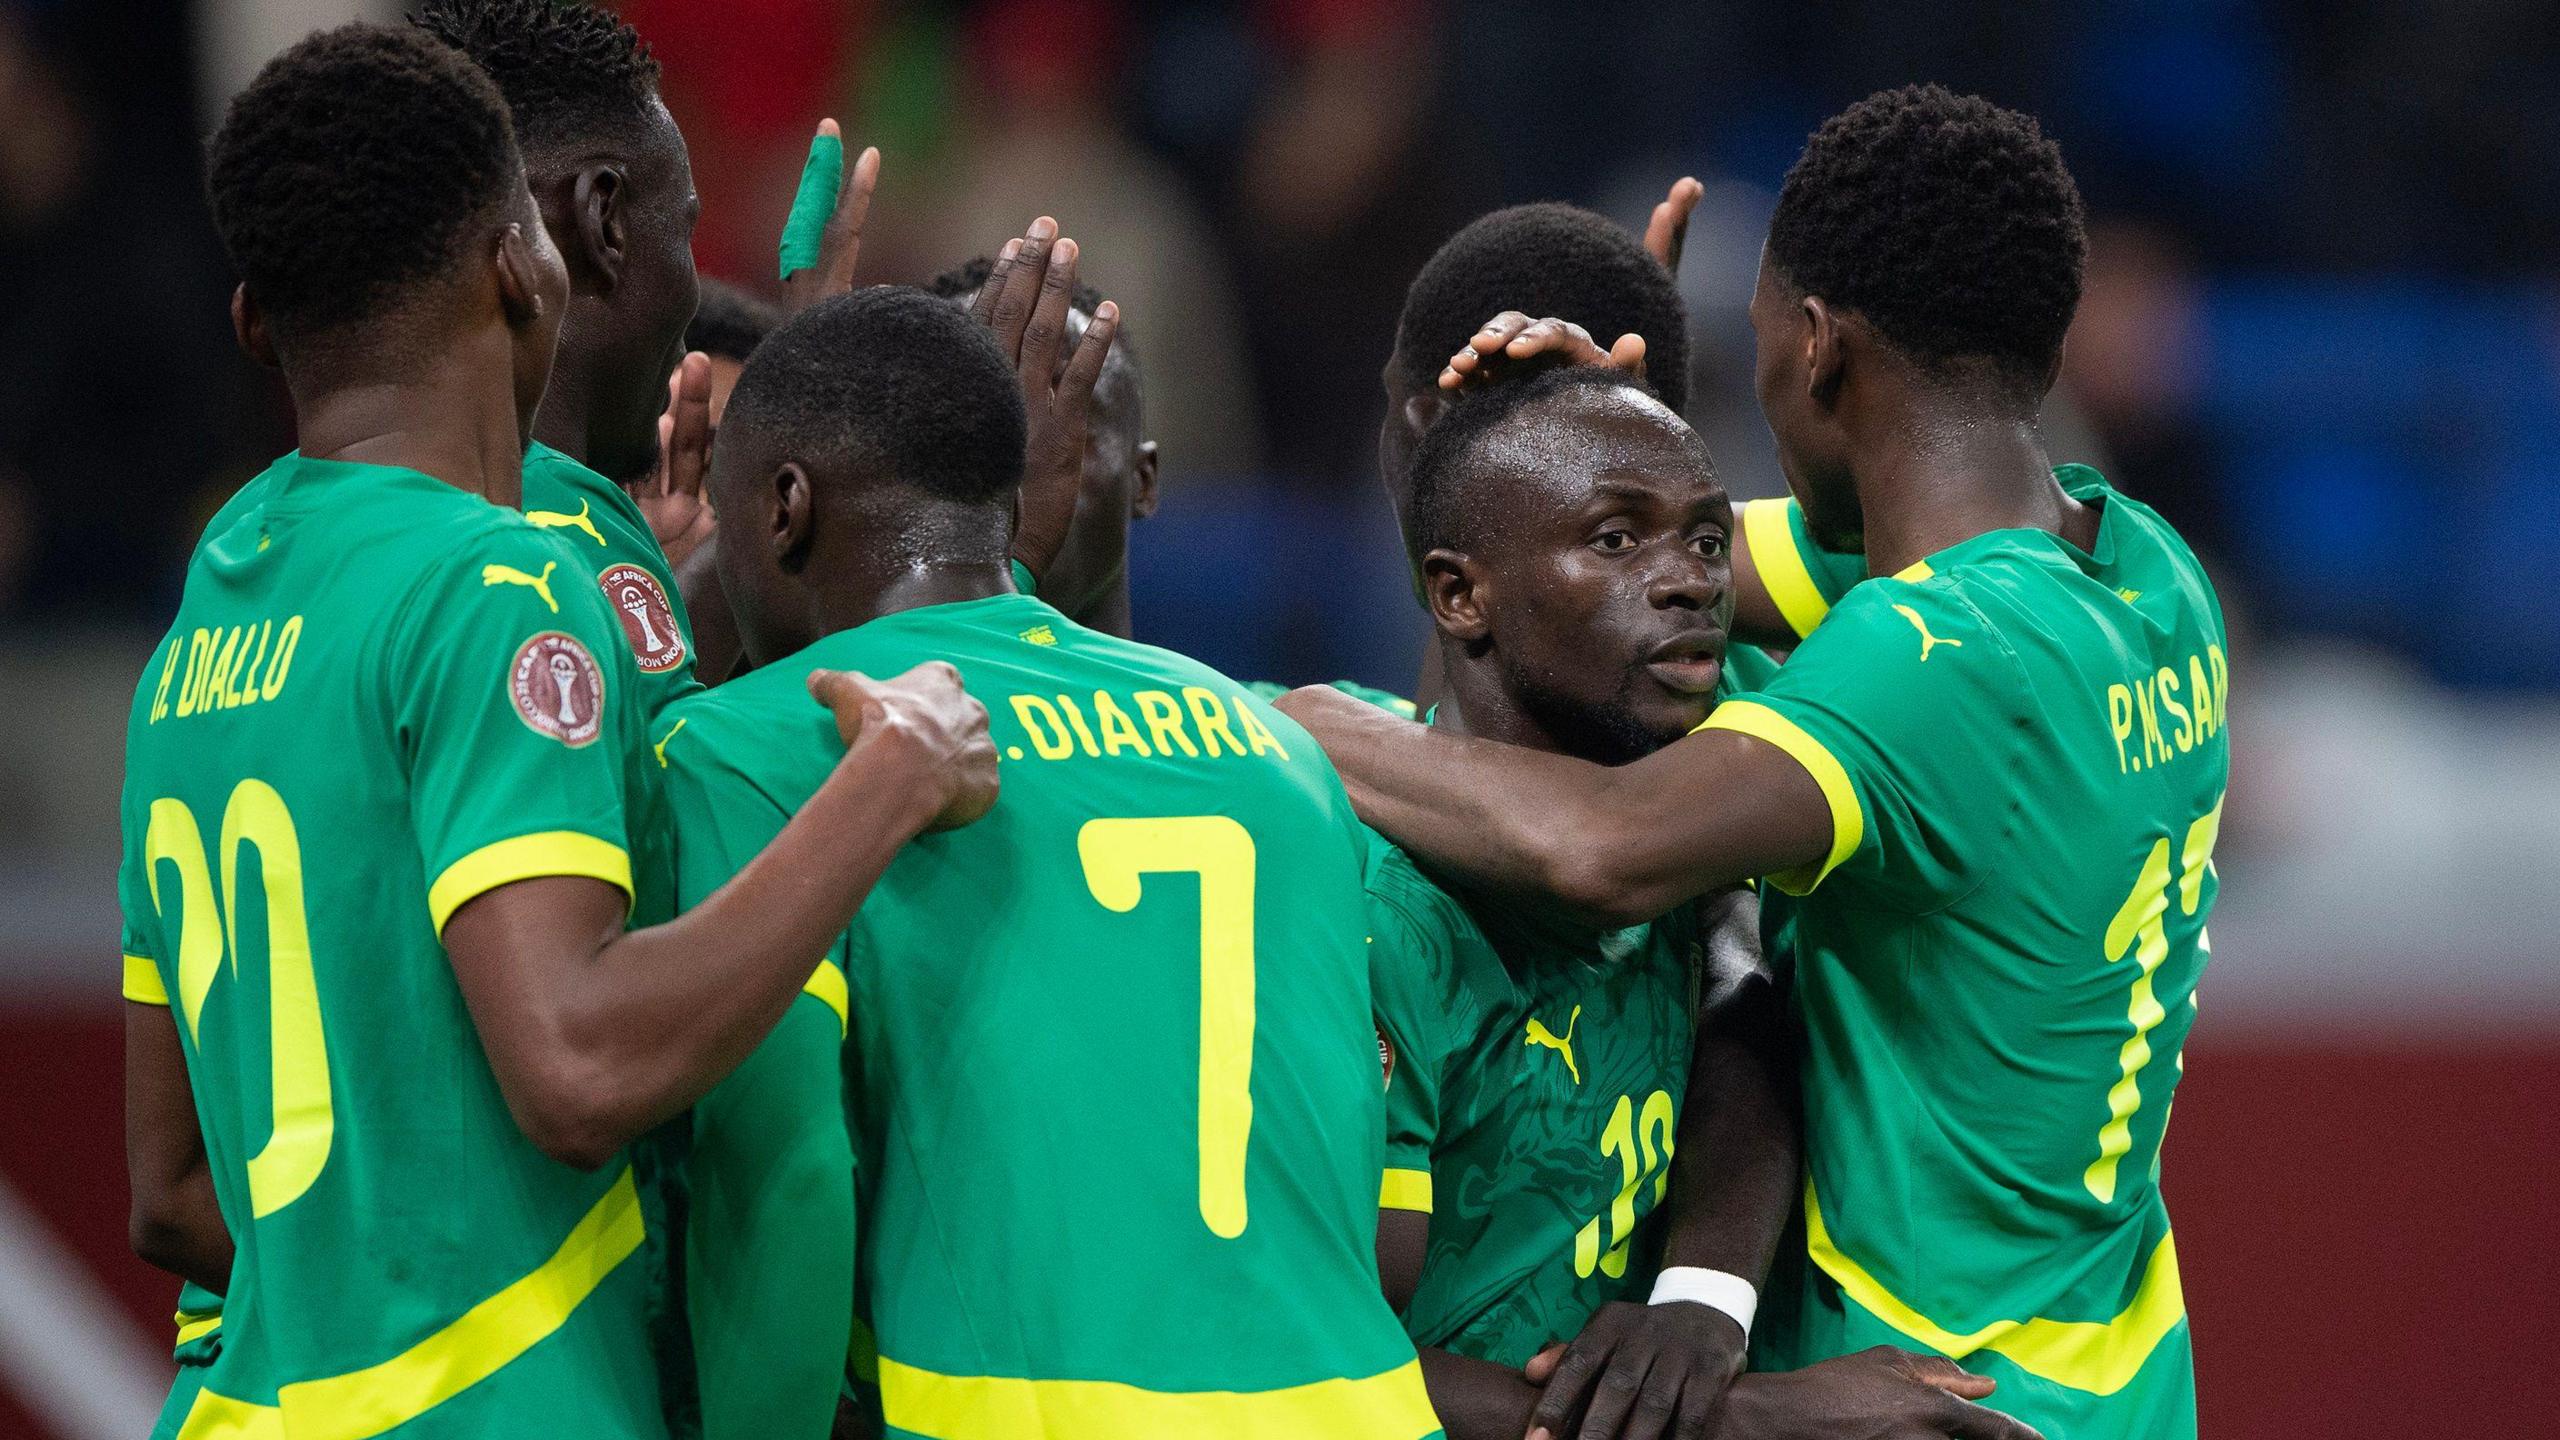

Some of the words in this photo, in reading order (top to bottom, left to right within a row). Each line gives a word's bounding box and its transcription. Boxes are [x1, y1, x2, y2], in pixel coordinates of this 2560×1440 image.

[623, 570, 653, 592] AFRICA
[653, 590, 668, 611] CUP
[176, 615, 304, 718] DIALLO
[635, 655, 662, 668] MOR
[997, 686, 1290, 761] .DIARRA
[1077, 815, 1257, 1239] 7
[1574, 1089, 1675, 1279] 10
